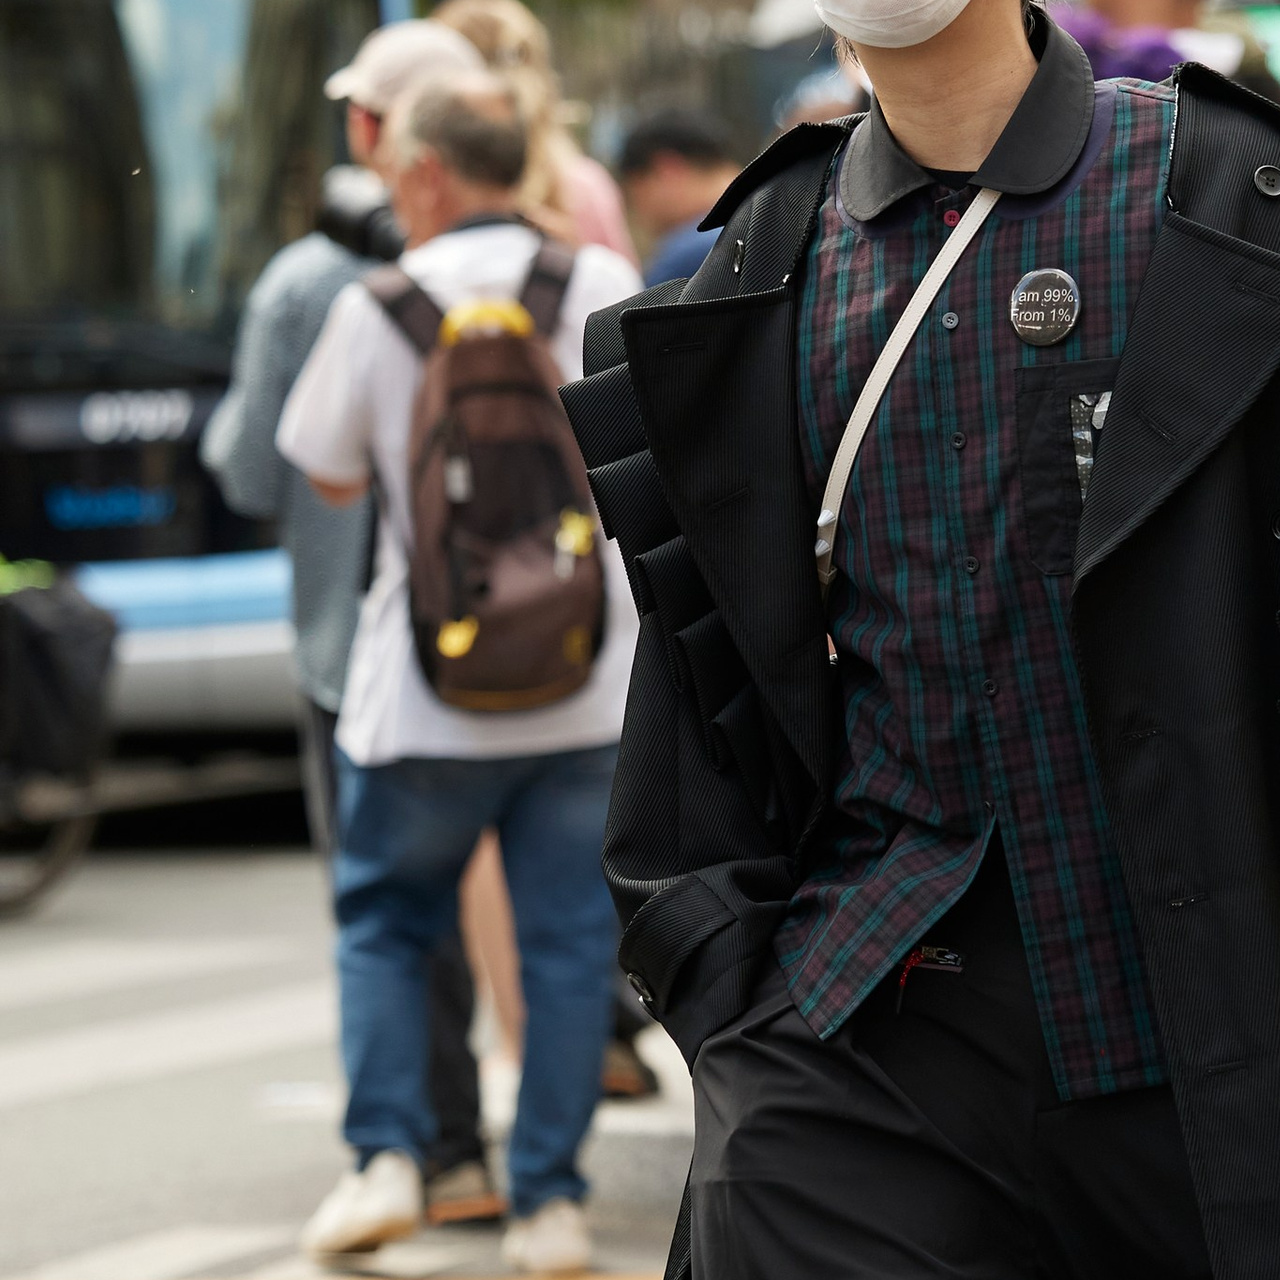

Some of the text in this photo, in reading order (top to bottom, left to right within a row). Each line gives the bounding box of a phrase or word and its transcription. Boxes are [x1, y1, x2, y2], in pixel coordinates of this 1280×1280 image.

[1019, 291, 1039, 302] am
[1043, 288, 1078, 302] 99%.
[1011, 308, 1075, 322] From 1%.
